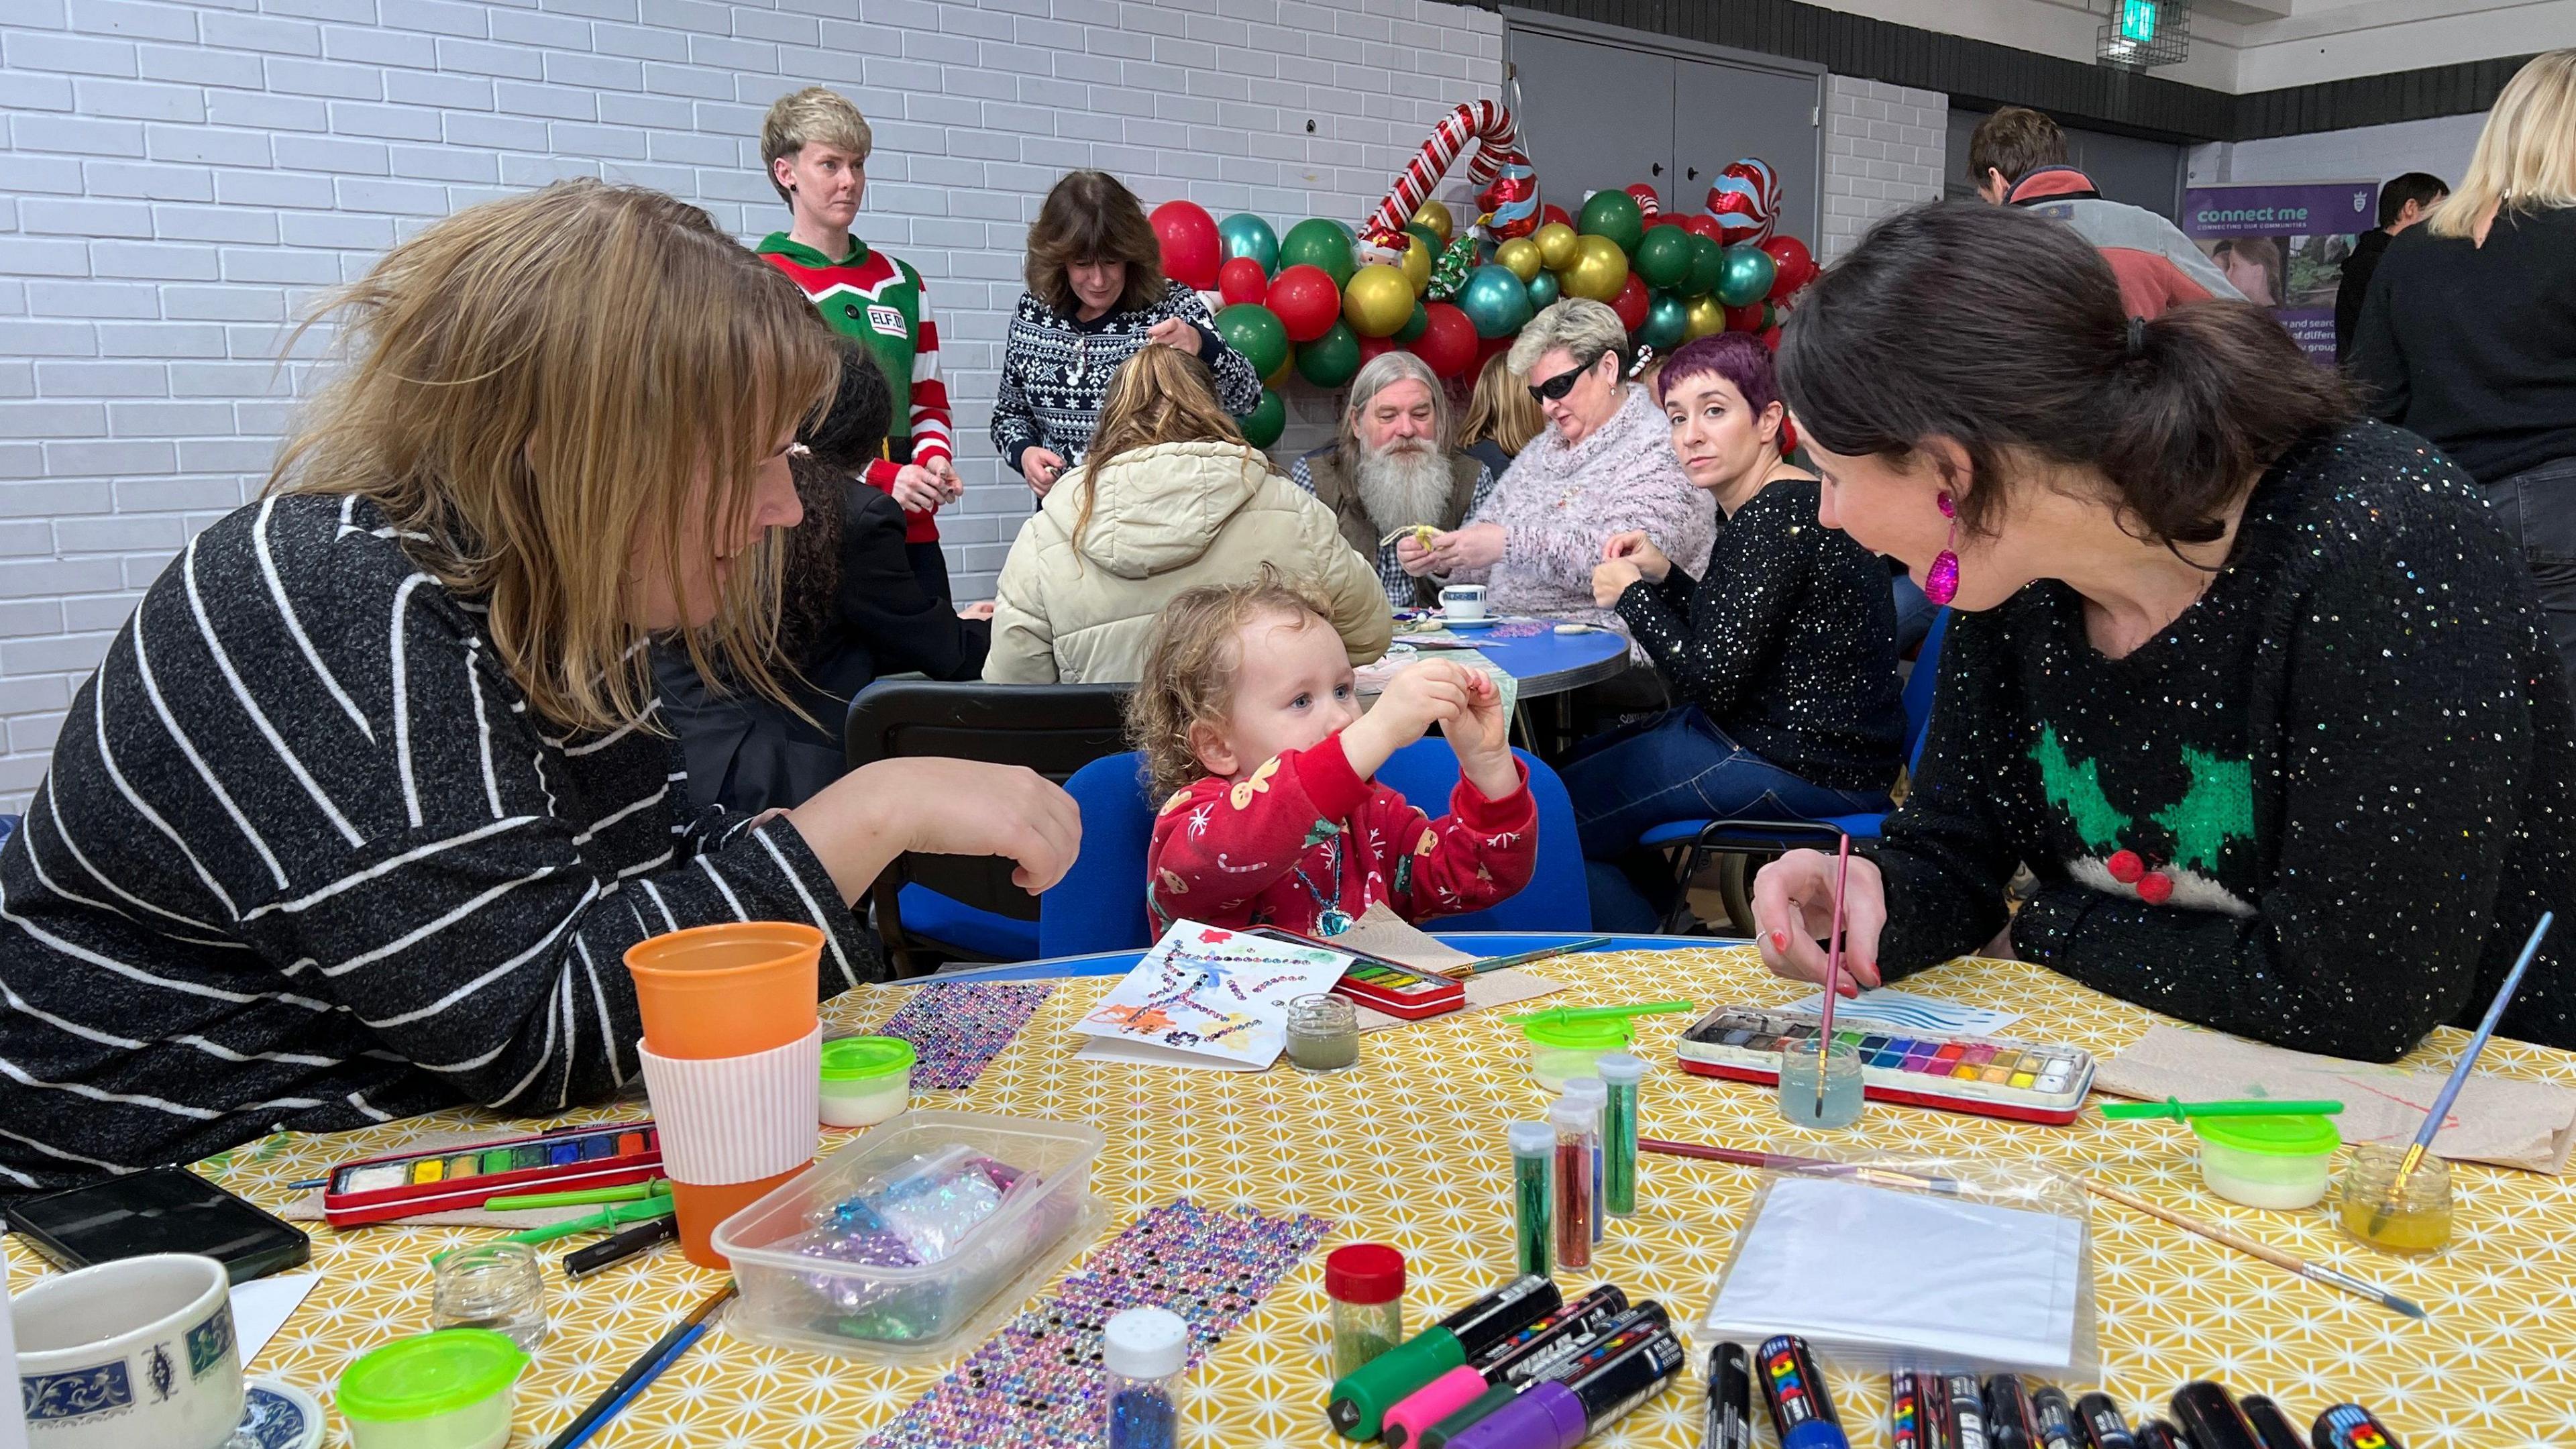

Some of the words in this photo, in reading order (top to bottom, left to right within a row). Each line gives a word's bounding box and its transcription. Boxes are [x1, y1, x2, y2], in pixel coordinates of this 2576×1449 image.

[2198, 207, 2274, 222] connect
[2278, 208, 2308, 221] me
[2290, 319, 2308, 328] and
